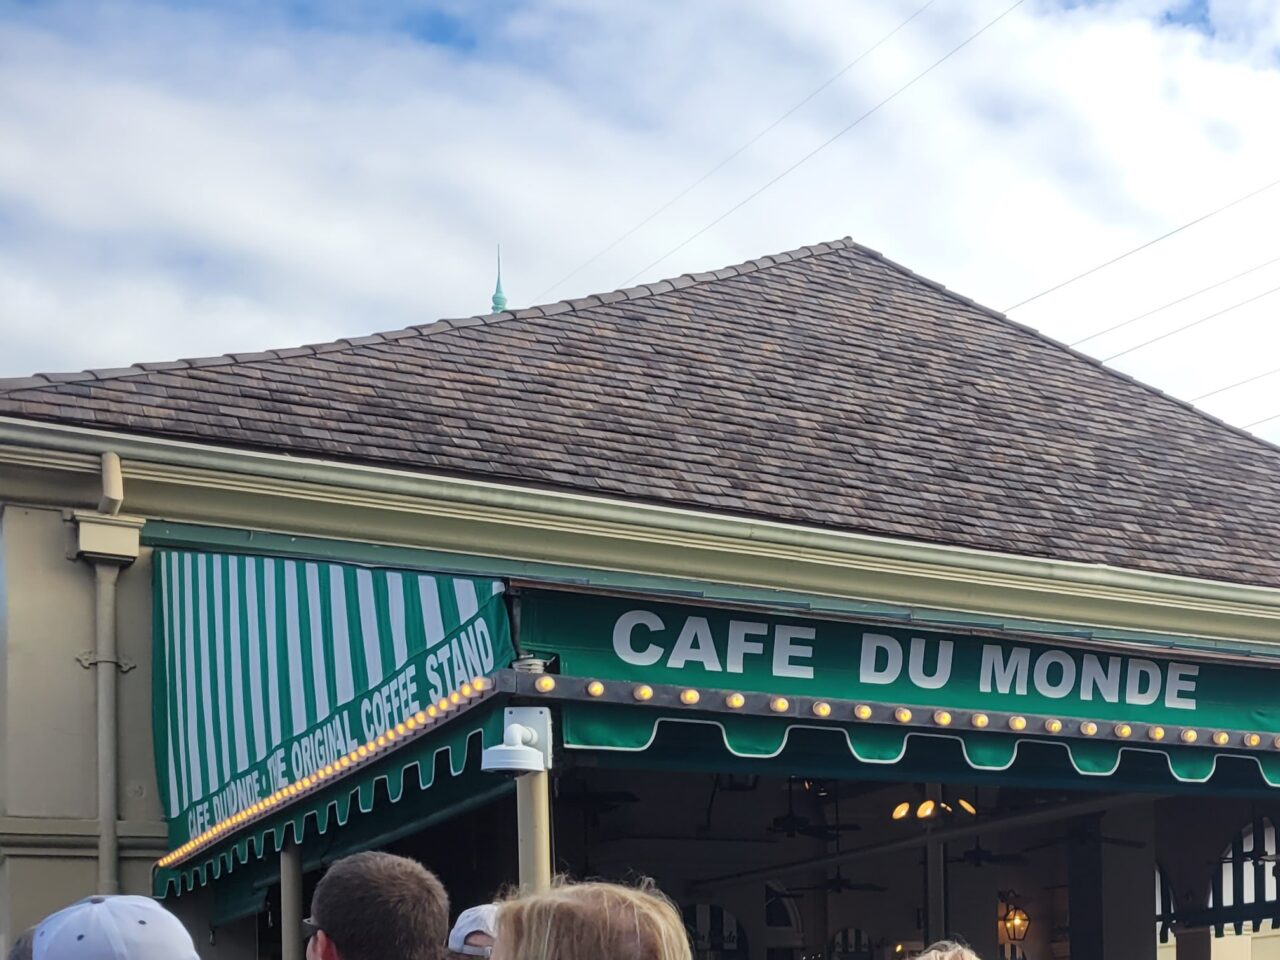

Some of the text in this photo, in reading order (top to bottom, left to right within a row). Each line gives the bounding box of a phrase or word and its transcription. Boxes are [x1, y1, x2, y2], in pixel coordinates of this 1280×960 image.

[291, 710, 358, 781] ORIGINAL
[361, 664, 420, 742] COFFEE
[425, 617, 495, 705] STAND
[612, 609, 1200, 711] CAFE DU MONDE
